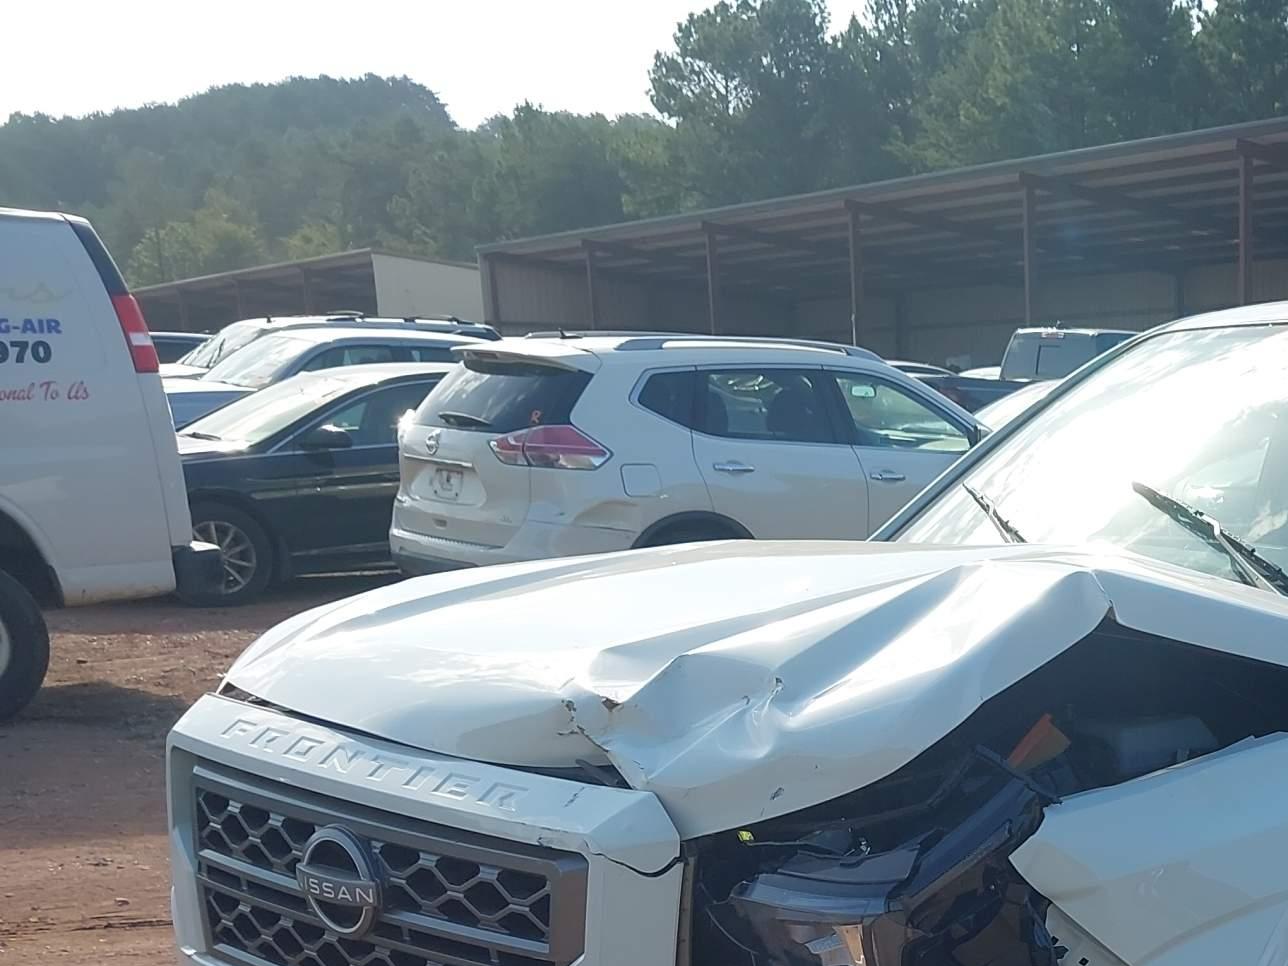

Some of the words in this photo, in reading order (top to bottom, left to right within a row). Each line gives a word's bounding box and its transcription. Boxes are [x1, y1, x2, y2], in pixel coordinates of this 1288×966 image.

[40, 381, 59, 401] To
[67, 381, 89, 400] Us
[219, 718, 529, 812] FRONTIER
